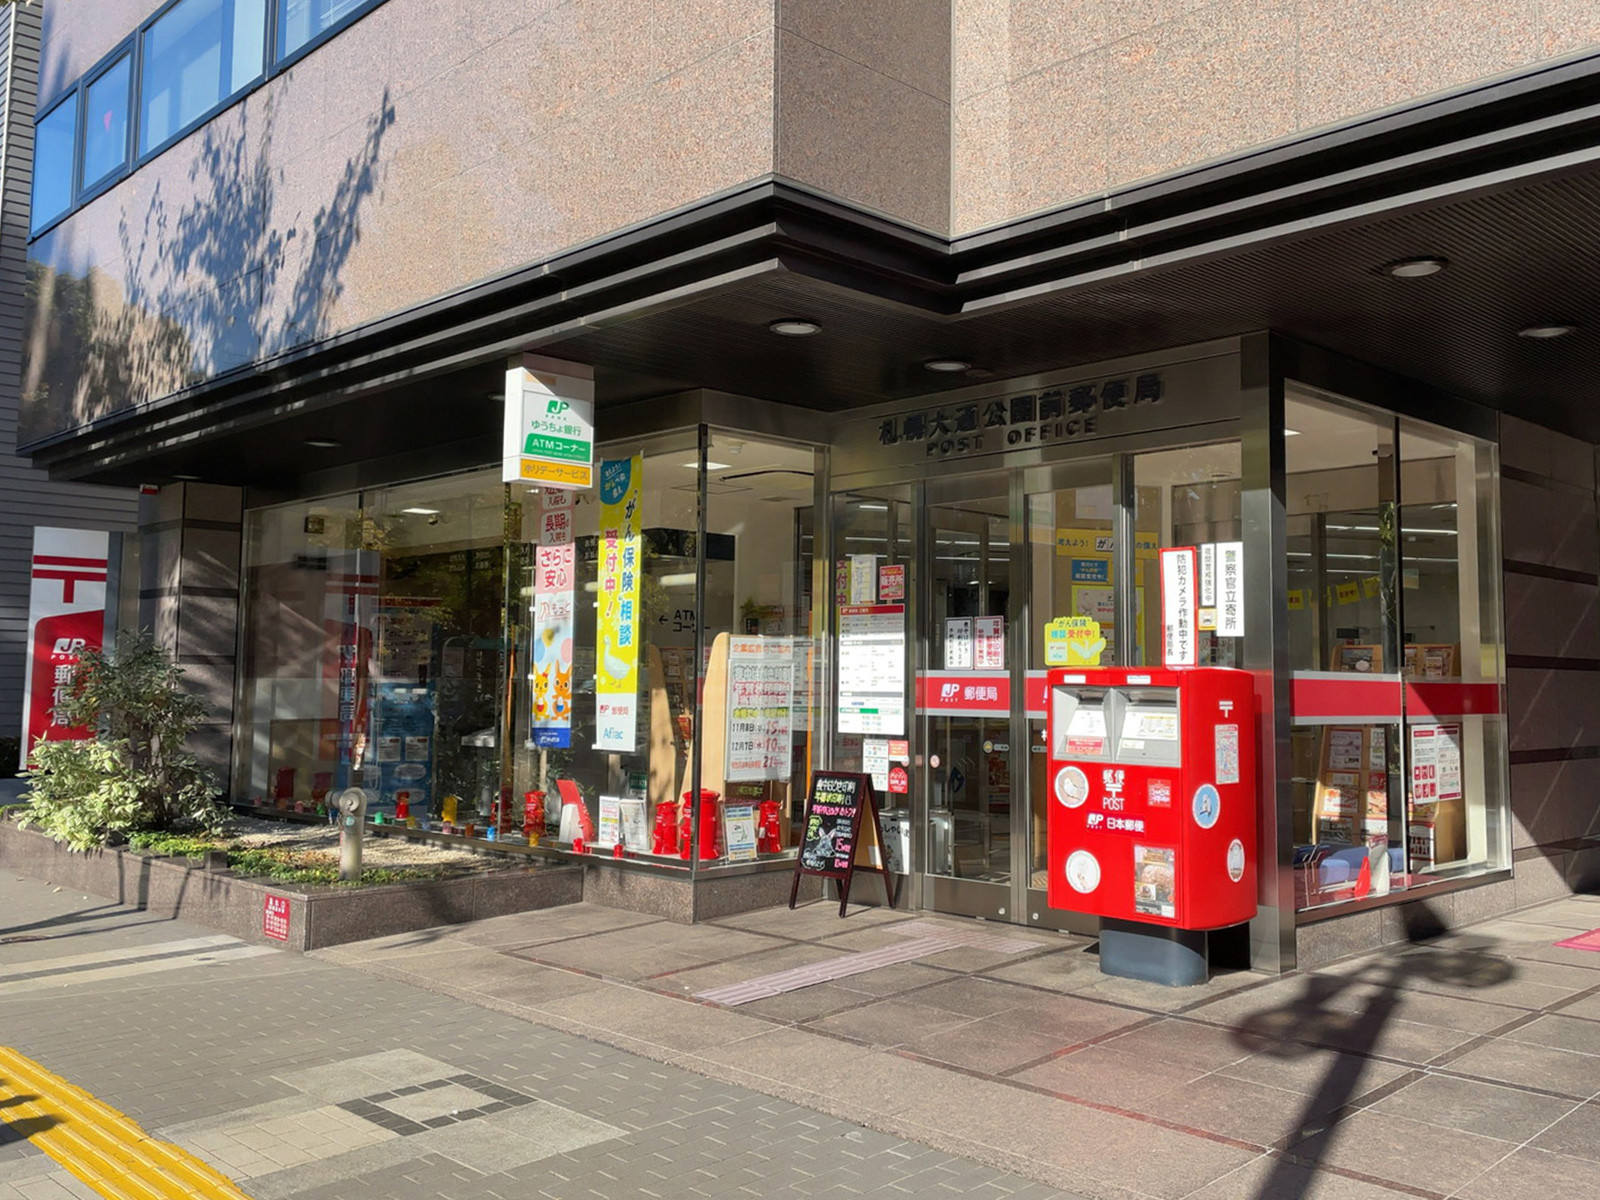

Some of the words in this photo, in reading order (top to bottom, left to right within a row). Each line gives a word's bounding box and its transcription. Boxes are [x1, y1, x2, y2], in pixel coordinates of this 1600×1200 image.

[531, 420, 581, 437] ゆうちょ銀行
[926, 436, 983, 457] POST
[1007, 416, 1098, 445] OFFICE
[532, 438, 586, 453] ATMコーナー
[524, 464, 588, 480] ホリデーサービス
[541, 548, 572, 568] さらに
[544, 569, 567, 588] 安心
[1225, 549, 1238, 630] 警察官立寄所
[1176, 553, 1189, 662] 防犯カメラ作動中です
[964, 686, 998, 701] 郵便局
[603, 726, 623, 740] Aflac
[1103, 769, 1125, 785] 郵便
[1103, 798, 1125, 811] POST
[1106, 817, 1144, 833] 日本郵便
